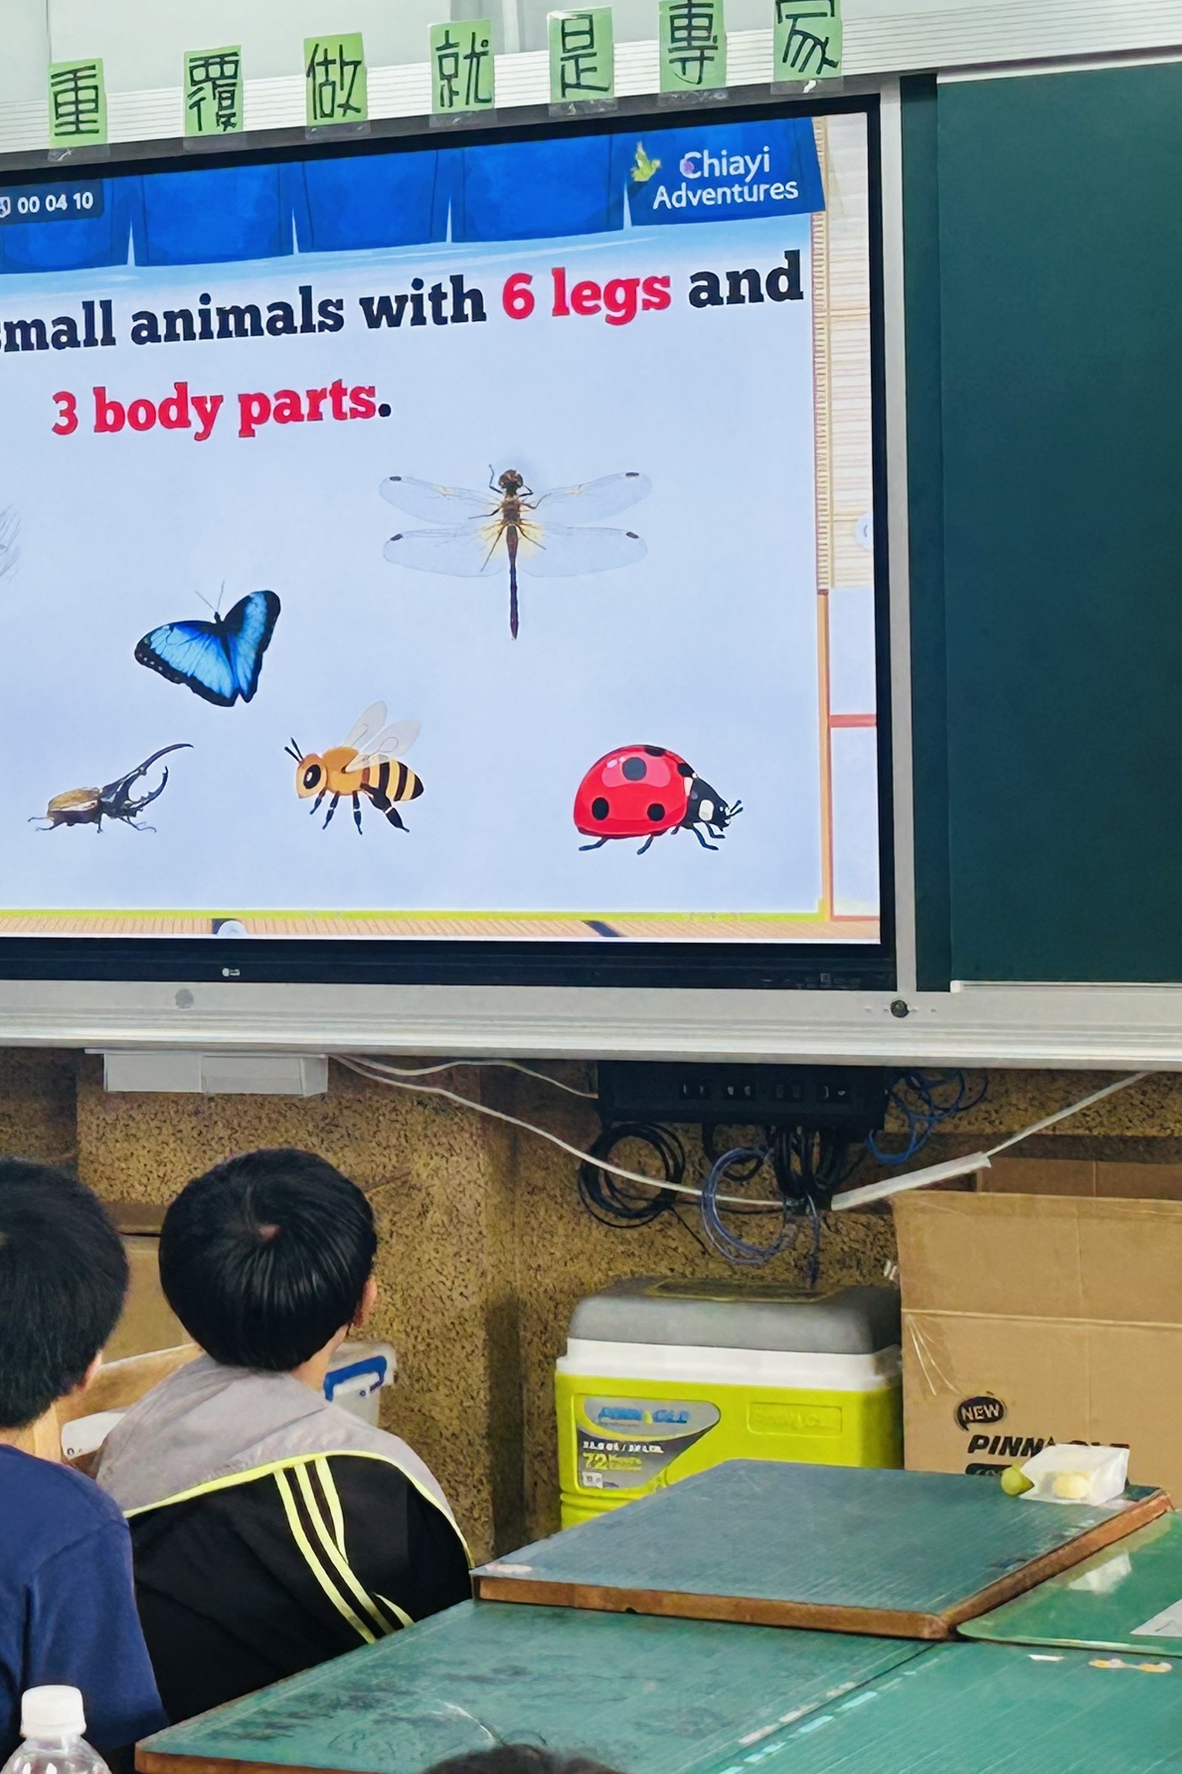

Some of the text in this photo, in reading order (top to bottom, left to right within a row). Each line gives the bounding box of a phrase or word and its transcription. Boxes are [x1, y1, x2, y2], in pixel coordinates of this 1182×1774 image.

[680, 145, 770, 183] Chiayi
[17, 191, 94, 214] 00 04 10
[653, 181, 799, 210] Adventures
[131, 285, 344, 346] animals
[359, 274, 487, 330] with
[502, 273, 535, 320] 6
[551, 267, 672, 326] legs
[688, 250, 804, 309] and
[51, 379, 391, 442] 3 body parts.
[960, 1403, 1000, 1421] NEW
[967, 1434, 1130, 1458] PINN
[582, 1452, 609, 1471] 72
